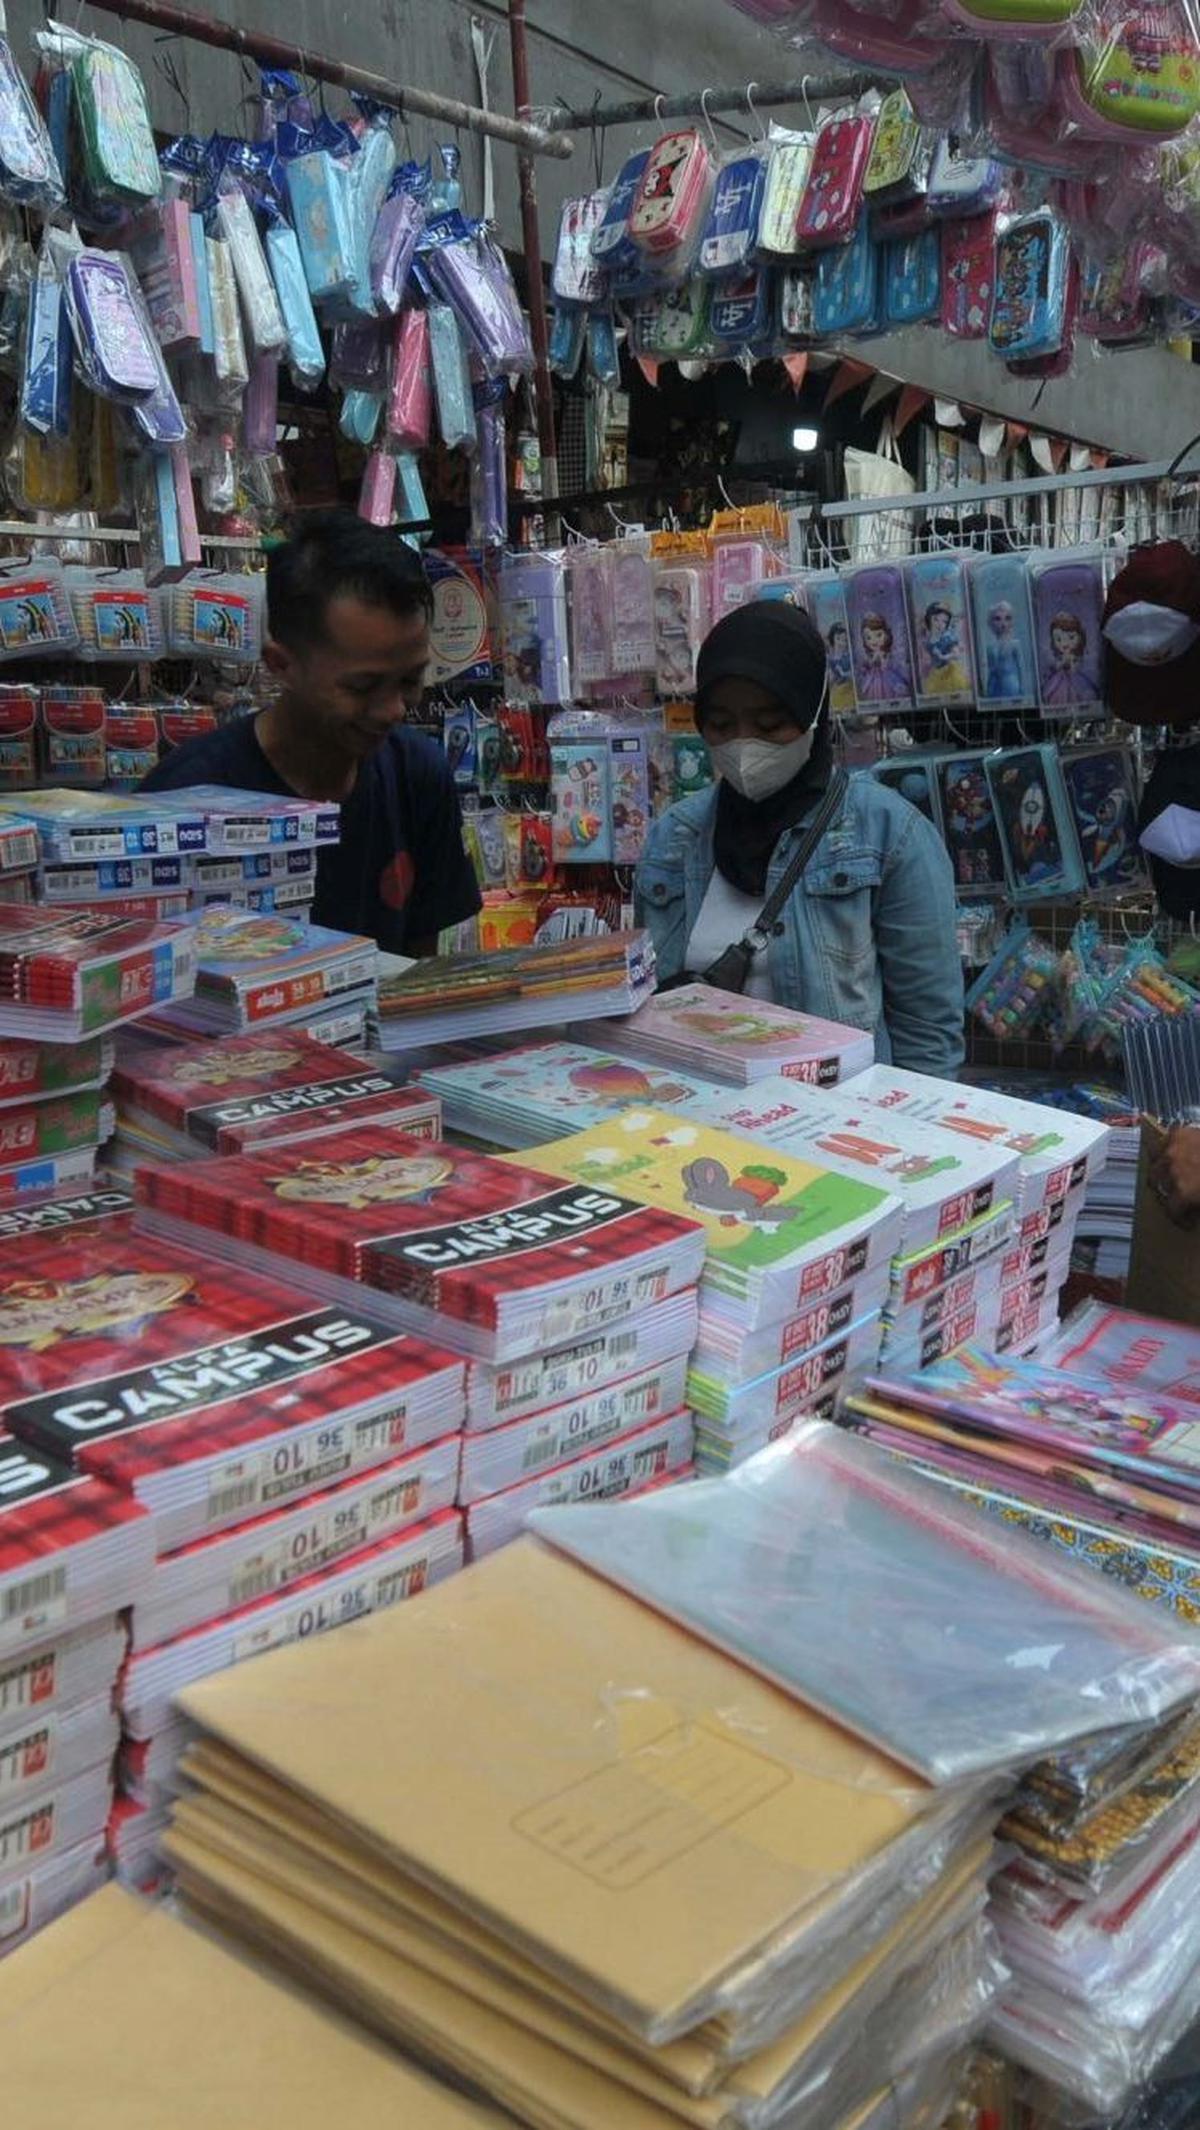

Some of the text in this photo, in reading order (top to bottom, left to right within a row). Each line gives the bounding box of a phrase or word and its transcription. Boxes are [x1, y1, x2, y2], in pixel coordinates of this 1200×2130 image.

[143, 832, 157, 847] 38
[215, 1077, 393, 1122] CAMPUS
[403, 1194, 622, 1263] CAMPUS
[824, 1251, 846, 1291] 38
[806, 1306, 829, 1347] 38
[53, 1319, 372, 1431] CAMPUS
[152, 1344, 250, 1381] ALFA
[578, 1357, 598, 1382] 10
[802, 1356, 824, 1396] 38
[318, 1427, 344, 1448] 36
[569, 1409, 588, 1434] 10
[274, 1443, 304, 1475] 10
[579, 1467, 598, 1493] 10
[335, 1502, 361, 1527] 36
[292, 1526, 319, 1559] 10
[299, 1605, 329, 1638] 10
